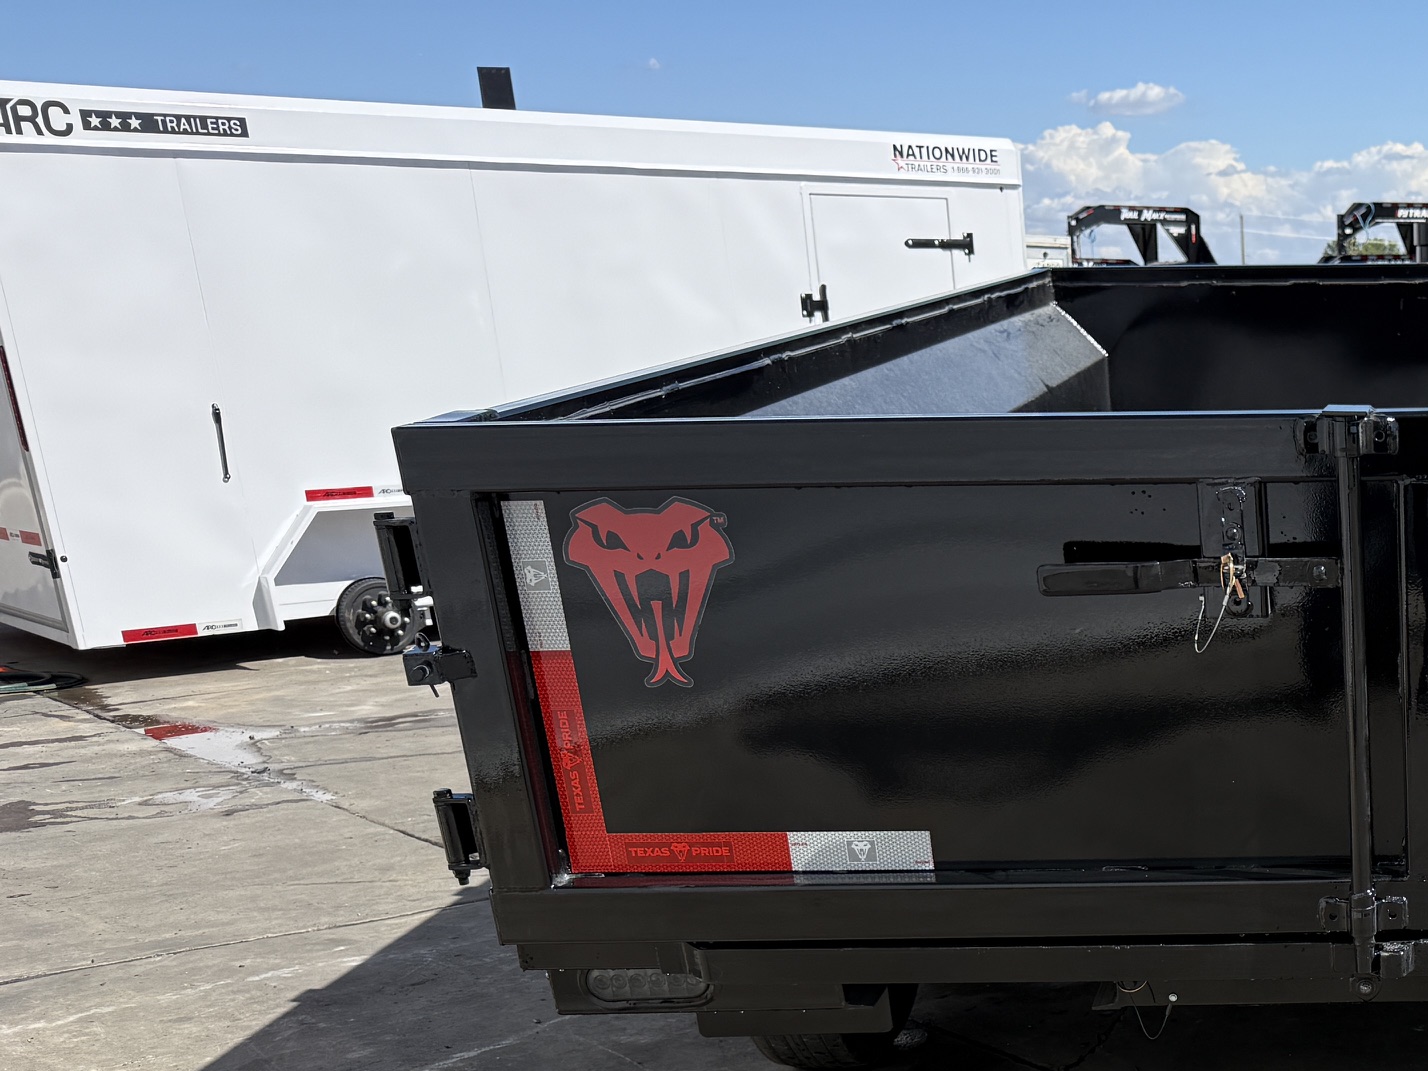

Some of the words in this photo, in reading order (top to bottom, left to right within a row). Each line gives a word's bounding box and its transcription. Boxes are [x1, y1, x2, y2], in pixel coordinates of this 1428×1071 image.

[154, 116, 242, 135] TRAILERS
[892, 144, 999, 163] NATIONWIDE
[905, 163, 948, 174] TRAILERS
[558, 710, 573, 749] PRIDE
[571, 770, 585, 812] TEXAS
[628, 847, 670, 857] TEXAS
[691, 846, 730, 856] PRIDE
